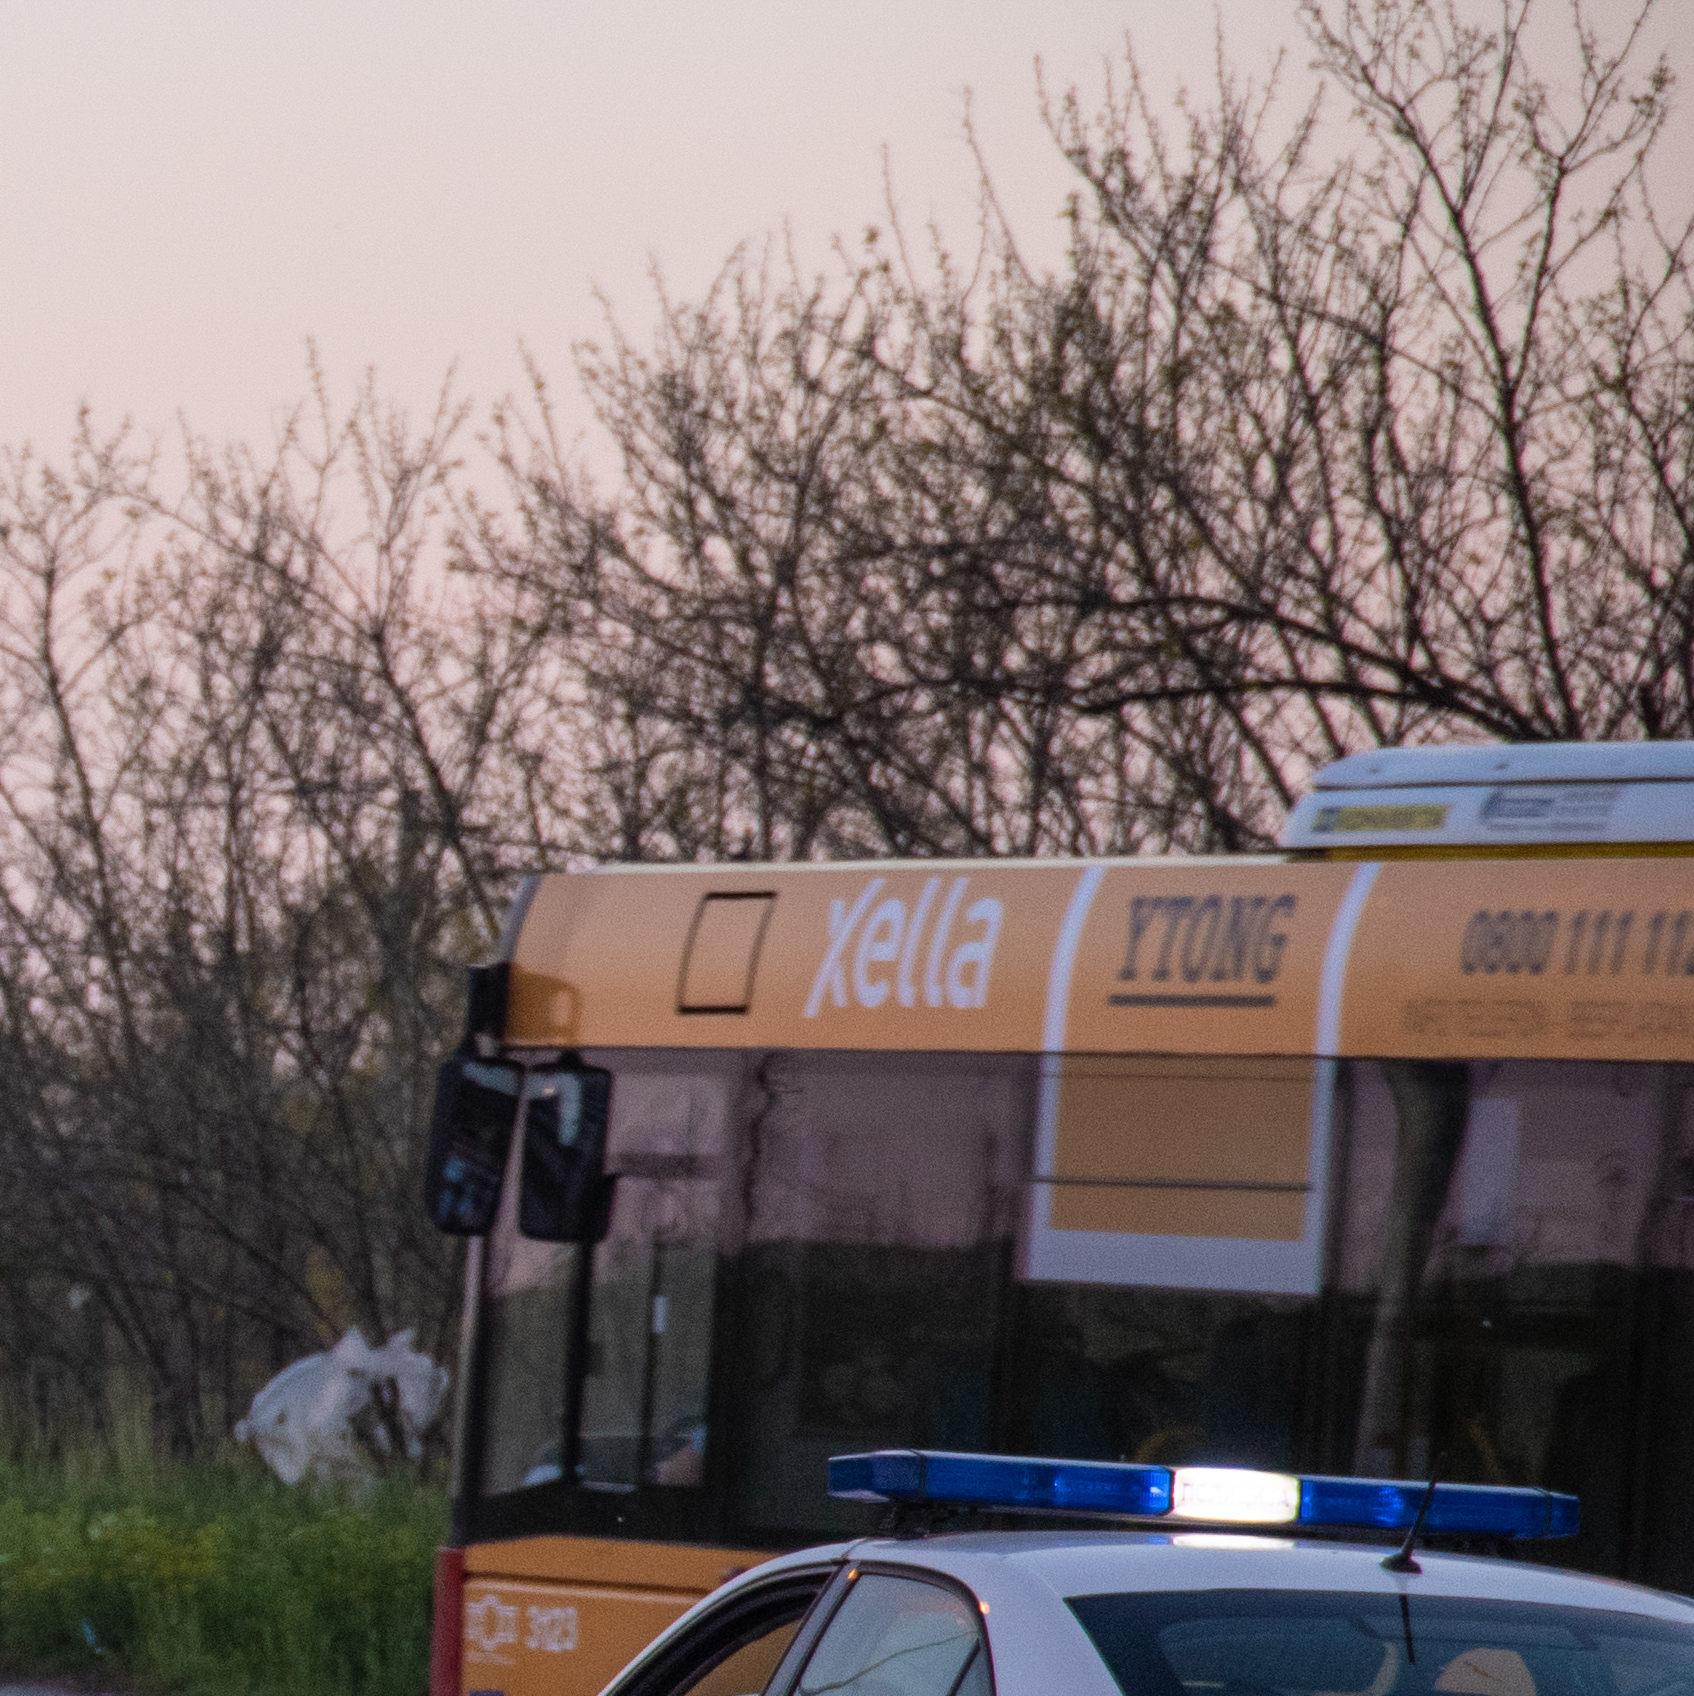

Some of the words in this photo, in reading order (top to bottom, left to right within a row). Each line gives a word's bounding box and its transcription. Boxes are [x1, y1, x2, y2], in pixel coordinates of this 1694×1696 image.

[803, 877, 1005, 1018] Xella
[1117, 895, 1298, 983] YTONG
[1461, 909, 1560, 976] 0800
[1565, 909, 1634, 976] 111
